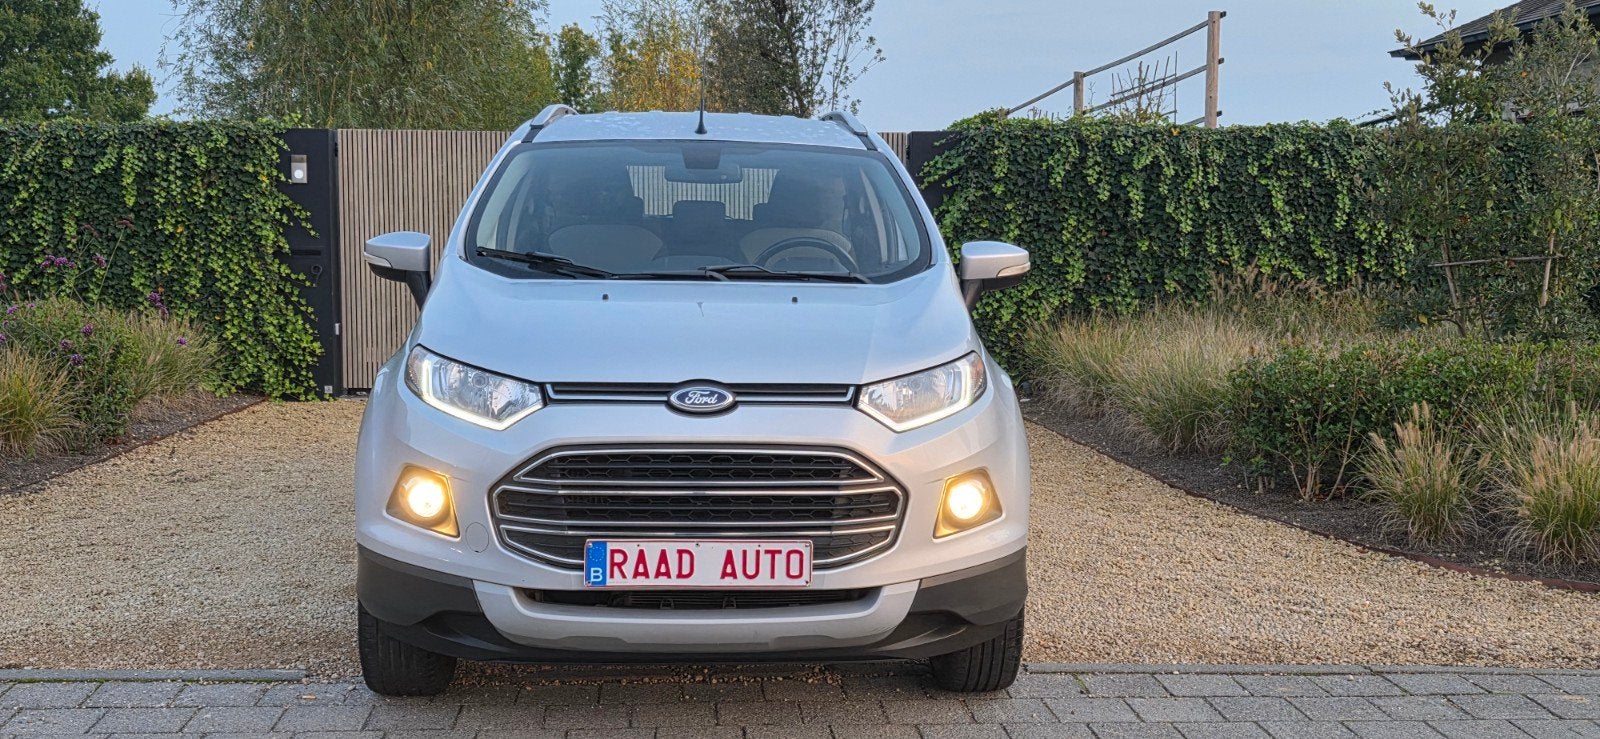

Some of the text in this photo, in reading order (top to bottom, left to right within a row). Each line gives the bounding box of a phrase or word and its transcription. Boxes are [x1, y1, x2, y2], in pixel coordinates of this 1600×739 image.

[684, 390, 718, 404] Ford
[609, 549, 805, 580] RAAD AUTO
[590, 567, 603, 582] B
